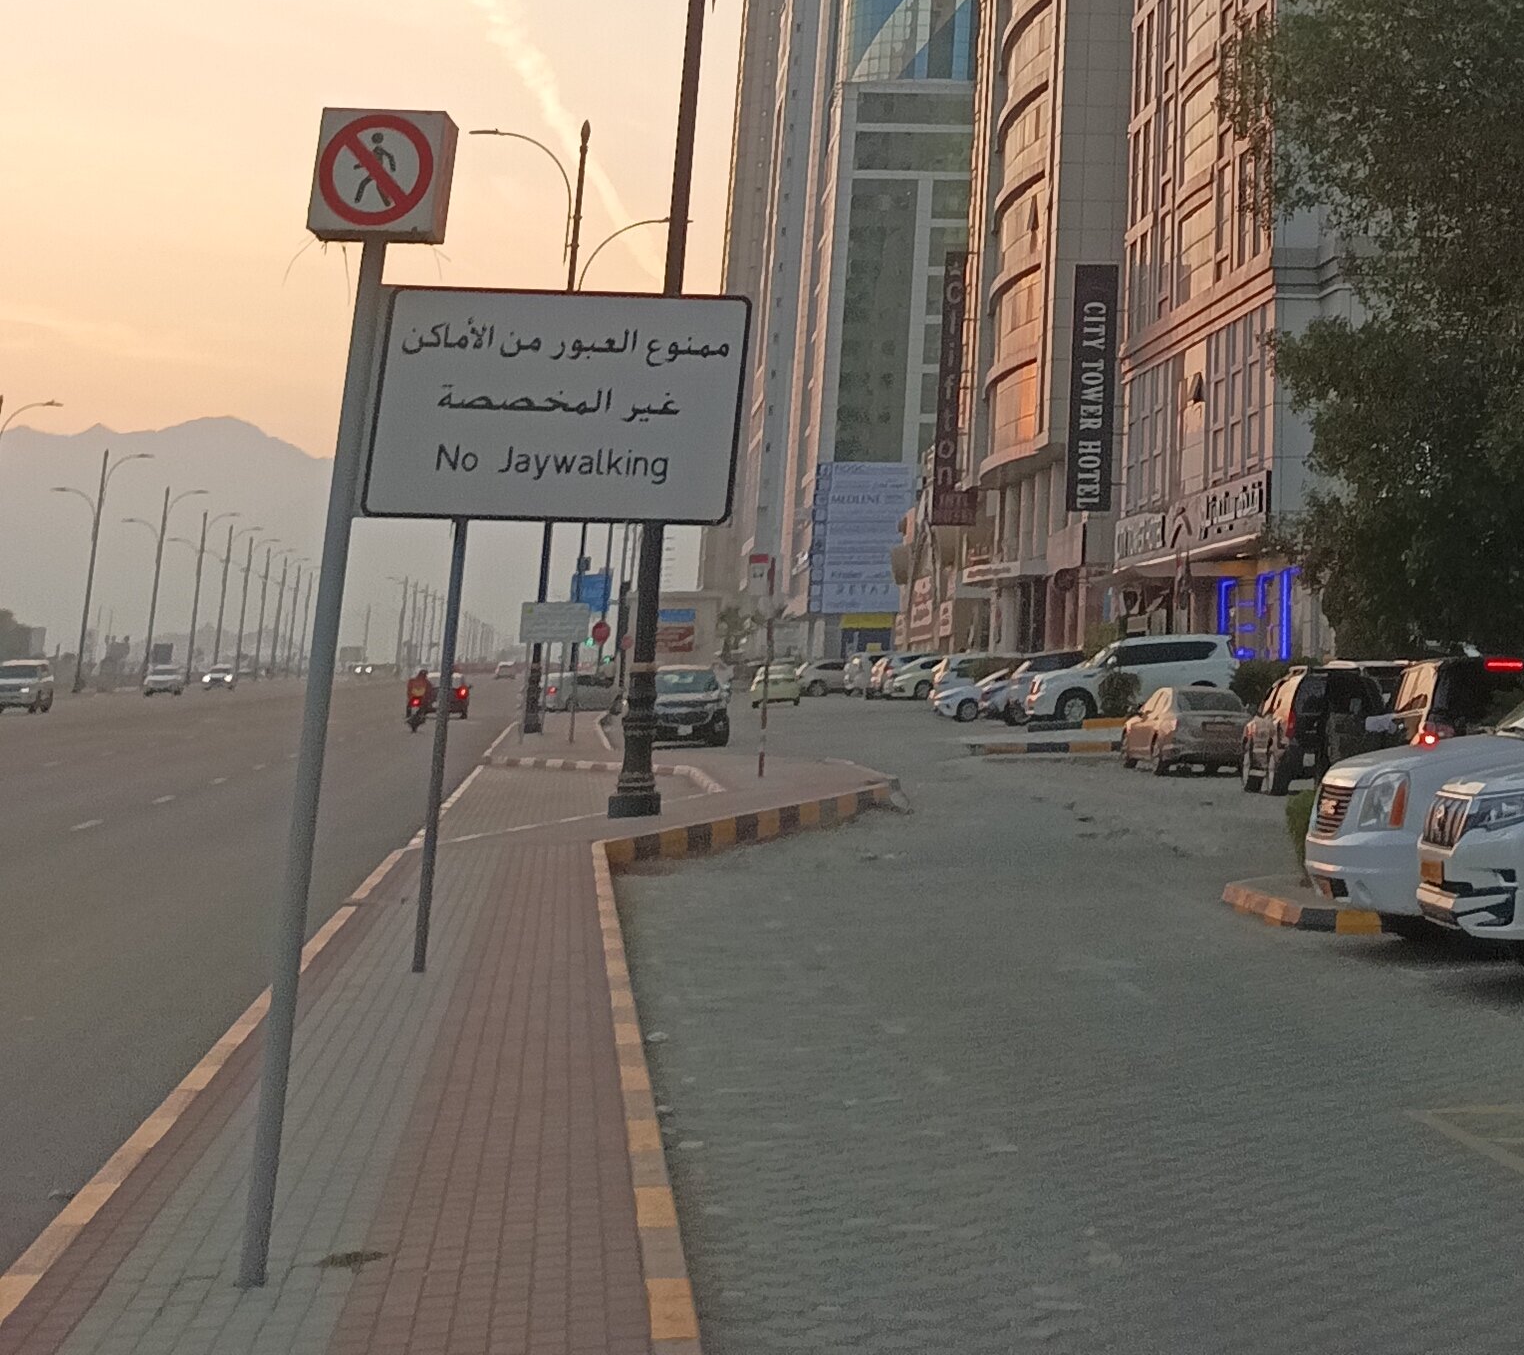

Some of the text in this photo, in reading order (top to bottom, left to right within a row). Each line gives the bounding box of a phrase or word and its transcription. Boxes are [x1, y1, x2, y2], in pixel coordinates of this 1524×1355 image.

[401, 317, 729, 367] ممنوع العبور من الأماكن
[437, 384, 680, 422] غير المخصصة
[1076, 301, 1107, 509] CITY TOWER HOTEL
[435, 443, 669, 485] No Jaywalking
